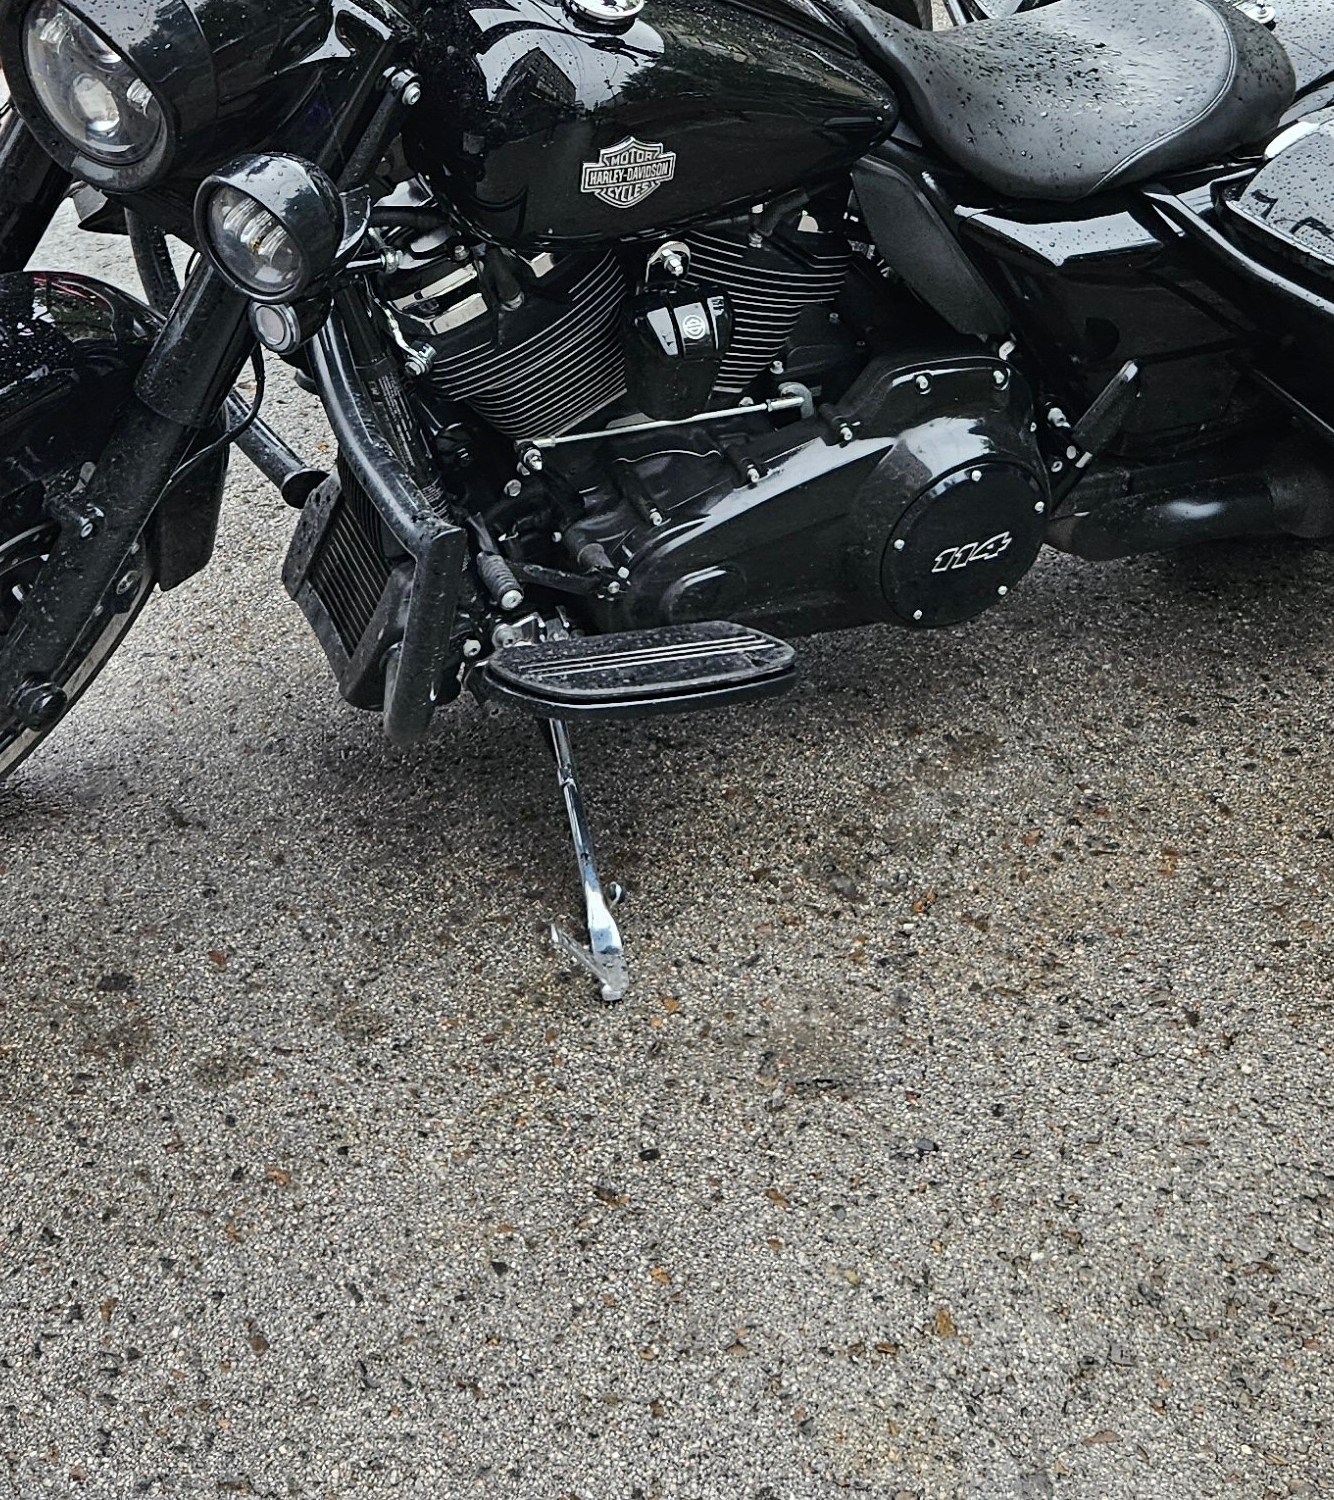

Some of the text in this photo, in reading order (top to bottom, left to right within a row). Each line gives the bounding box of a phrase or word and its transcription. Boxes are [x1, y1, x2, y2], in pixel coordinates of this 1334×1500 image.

[610, 148, 656, 166] MOTOR
[589, 161, 669, 185] HARLEY-DAVIDSON
[607, 181, 650, 202] CYCLES
[931, 531, 1012, 573] 114
